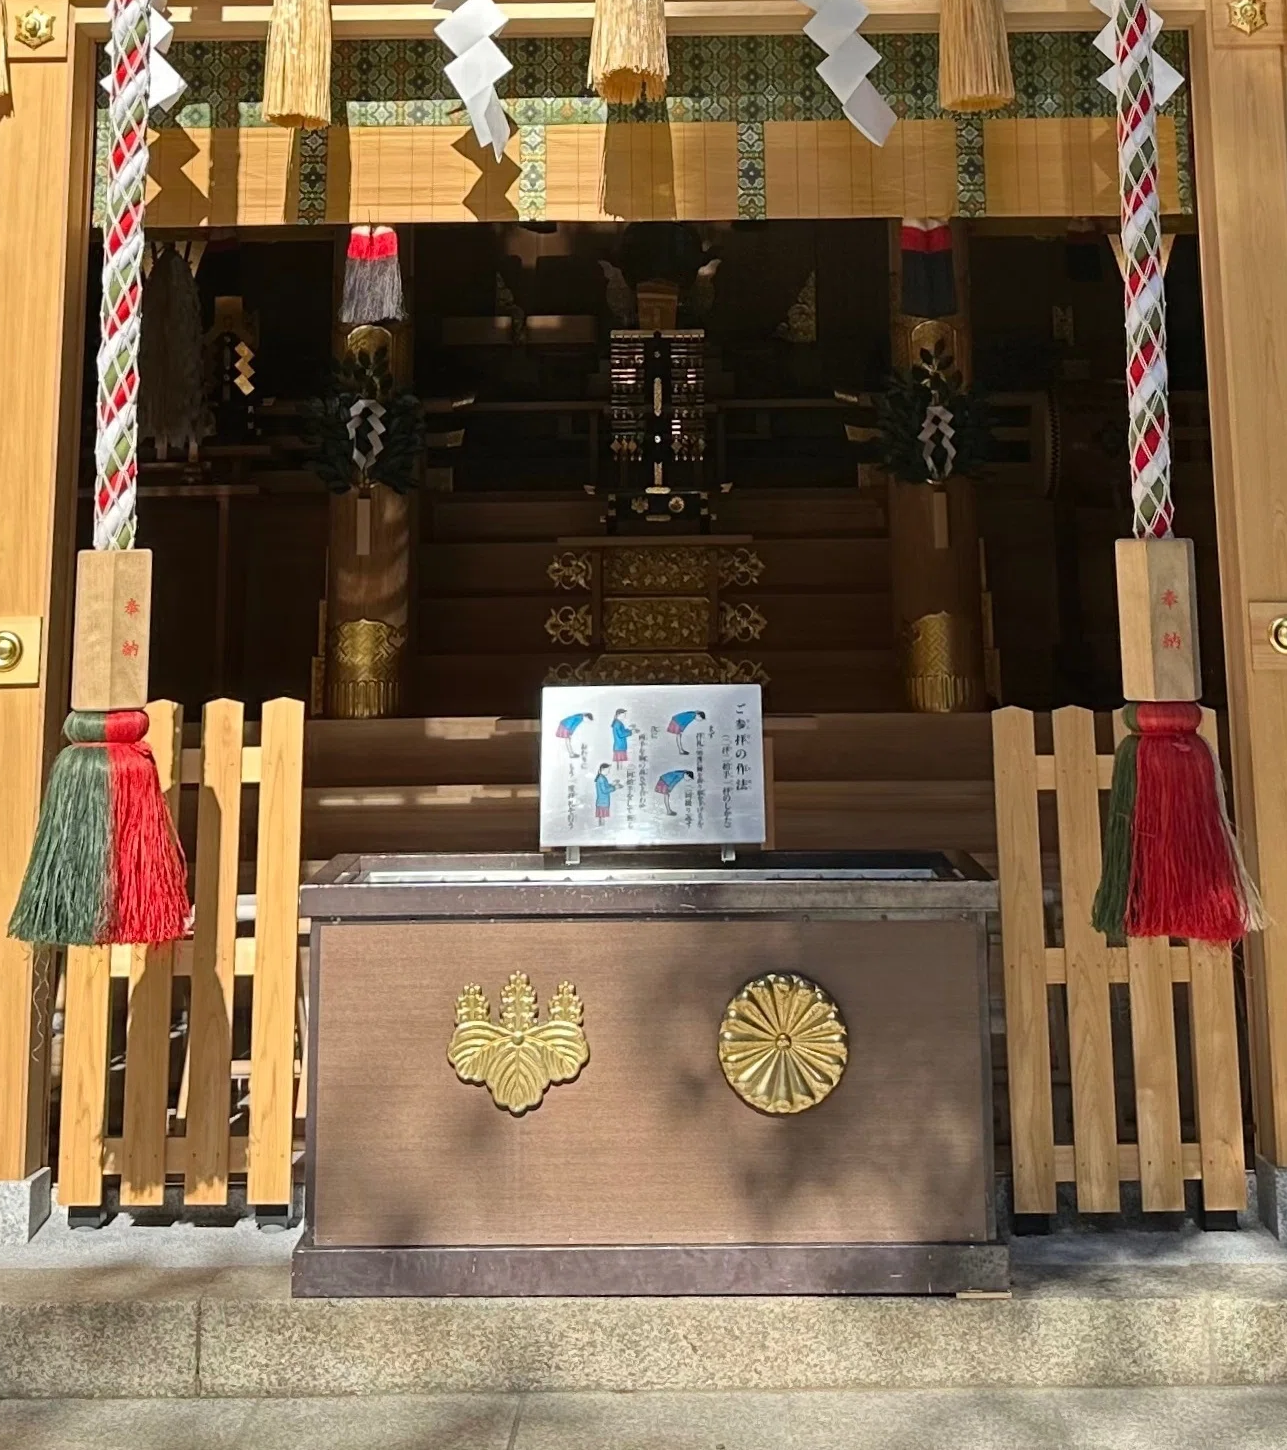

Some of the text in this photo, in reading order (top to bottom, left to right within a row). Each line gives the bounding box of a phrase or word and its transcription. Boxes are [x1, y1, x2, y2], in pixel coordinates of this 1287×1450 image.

[121, 598, 140, 658] 奉納
[1160, 589, 1182, 649] 奉納
[734, 703, 748, 791] ご参拝の作法
